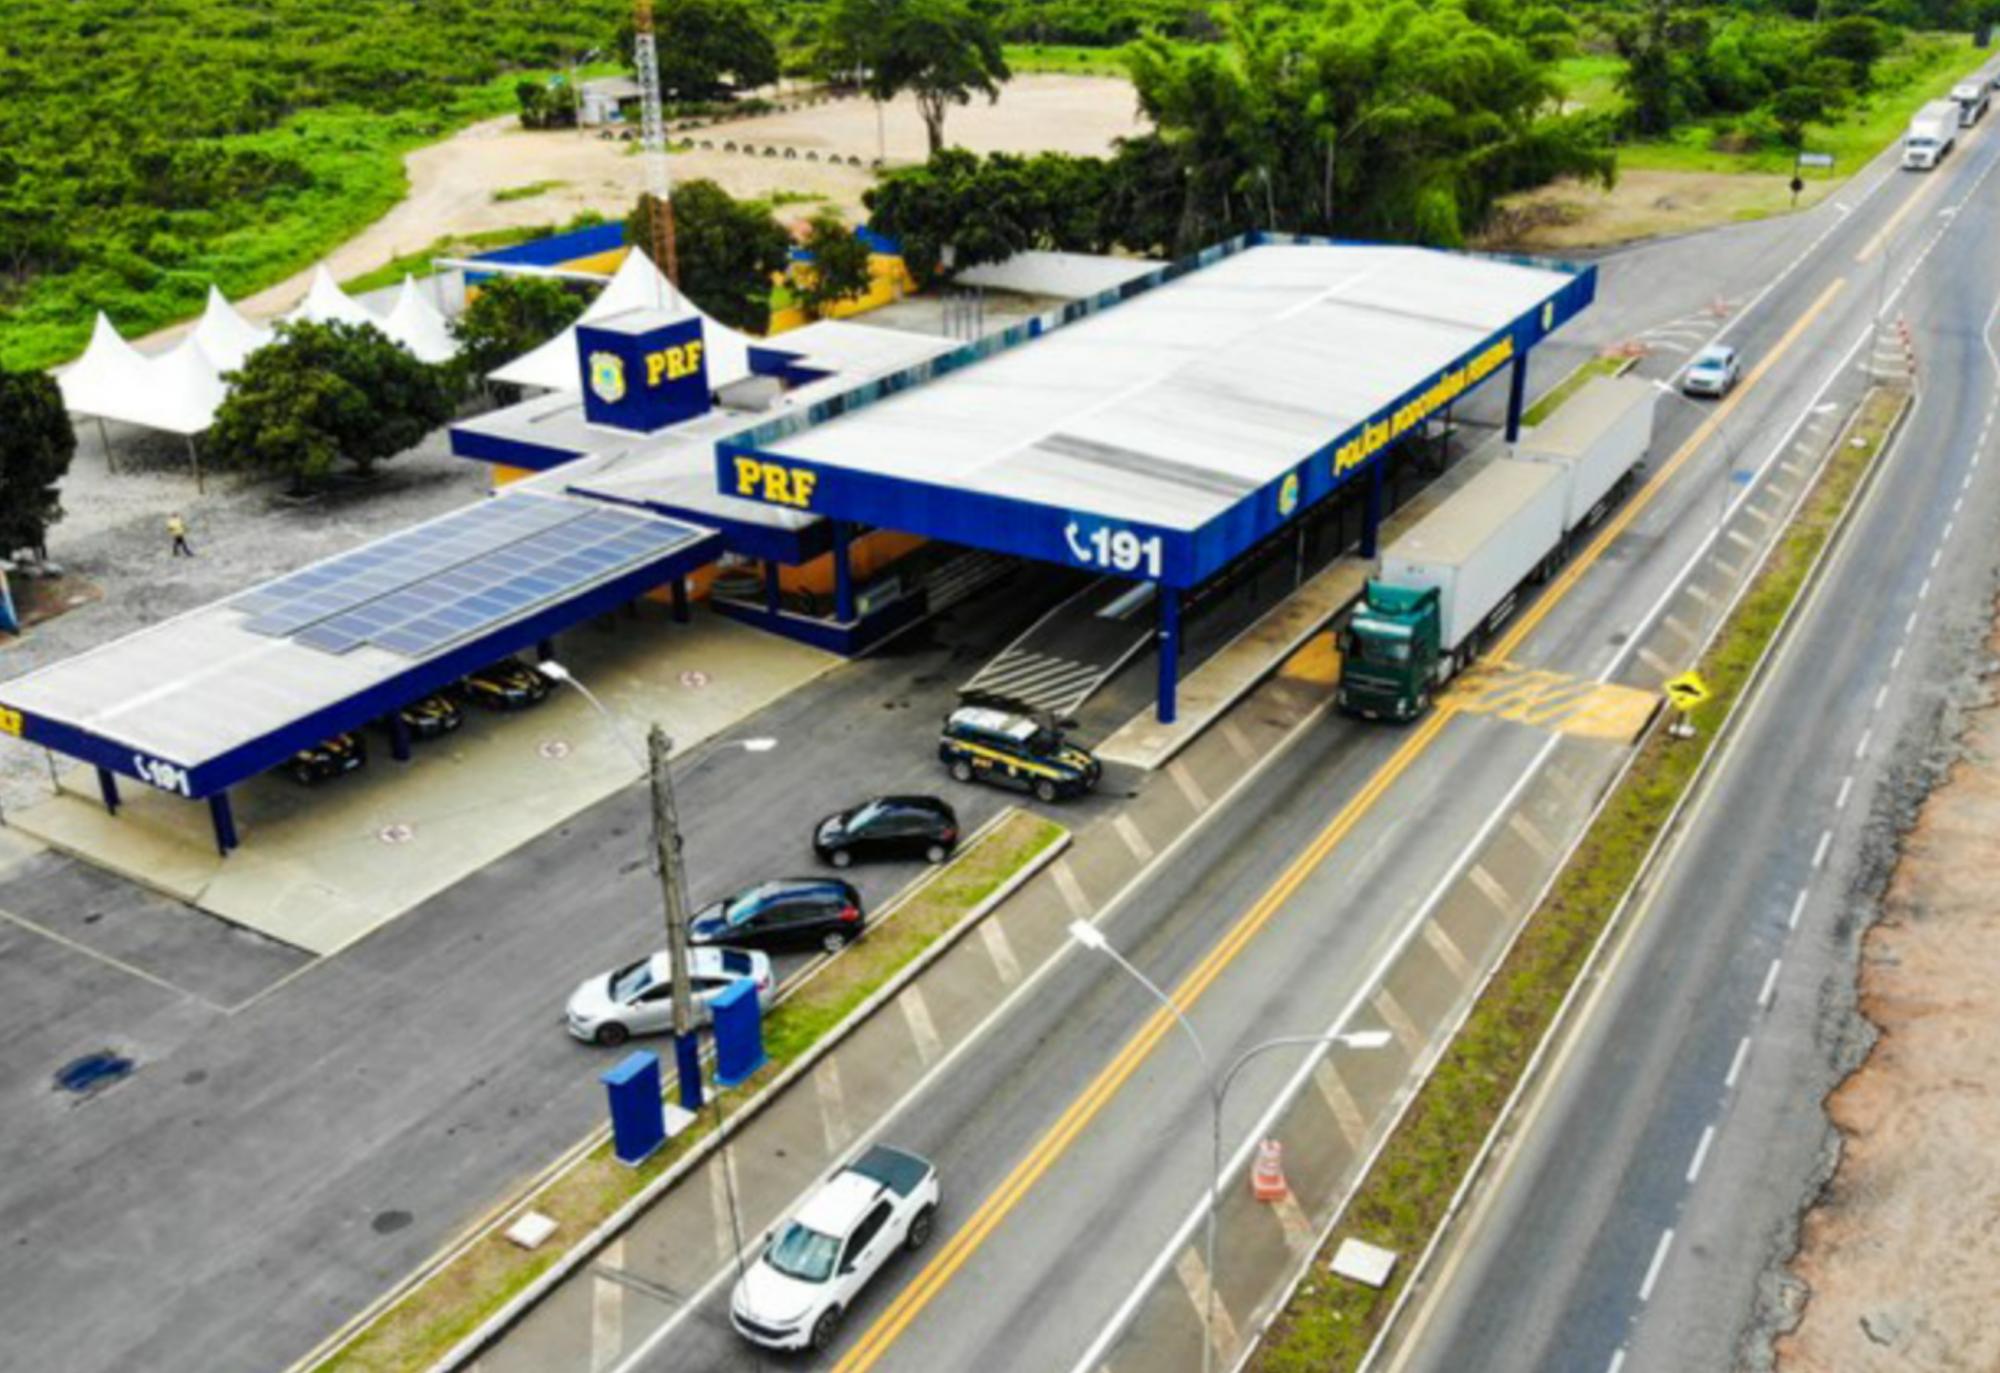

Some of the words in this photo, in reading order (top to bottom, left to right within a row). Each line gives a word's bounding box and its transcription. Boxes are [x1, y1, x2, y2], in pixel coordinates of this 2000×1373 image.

[646, 341, 702, 386] PRF
[734, 456, 816, 507] PRF
[1091, 526, 1161, 577] 191
